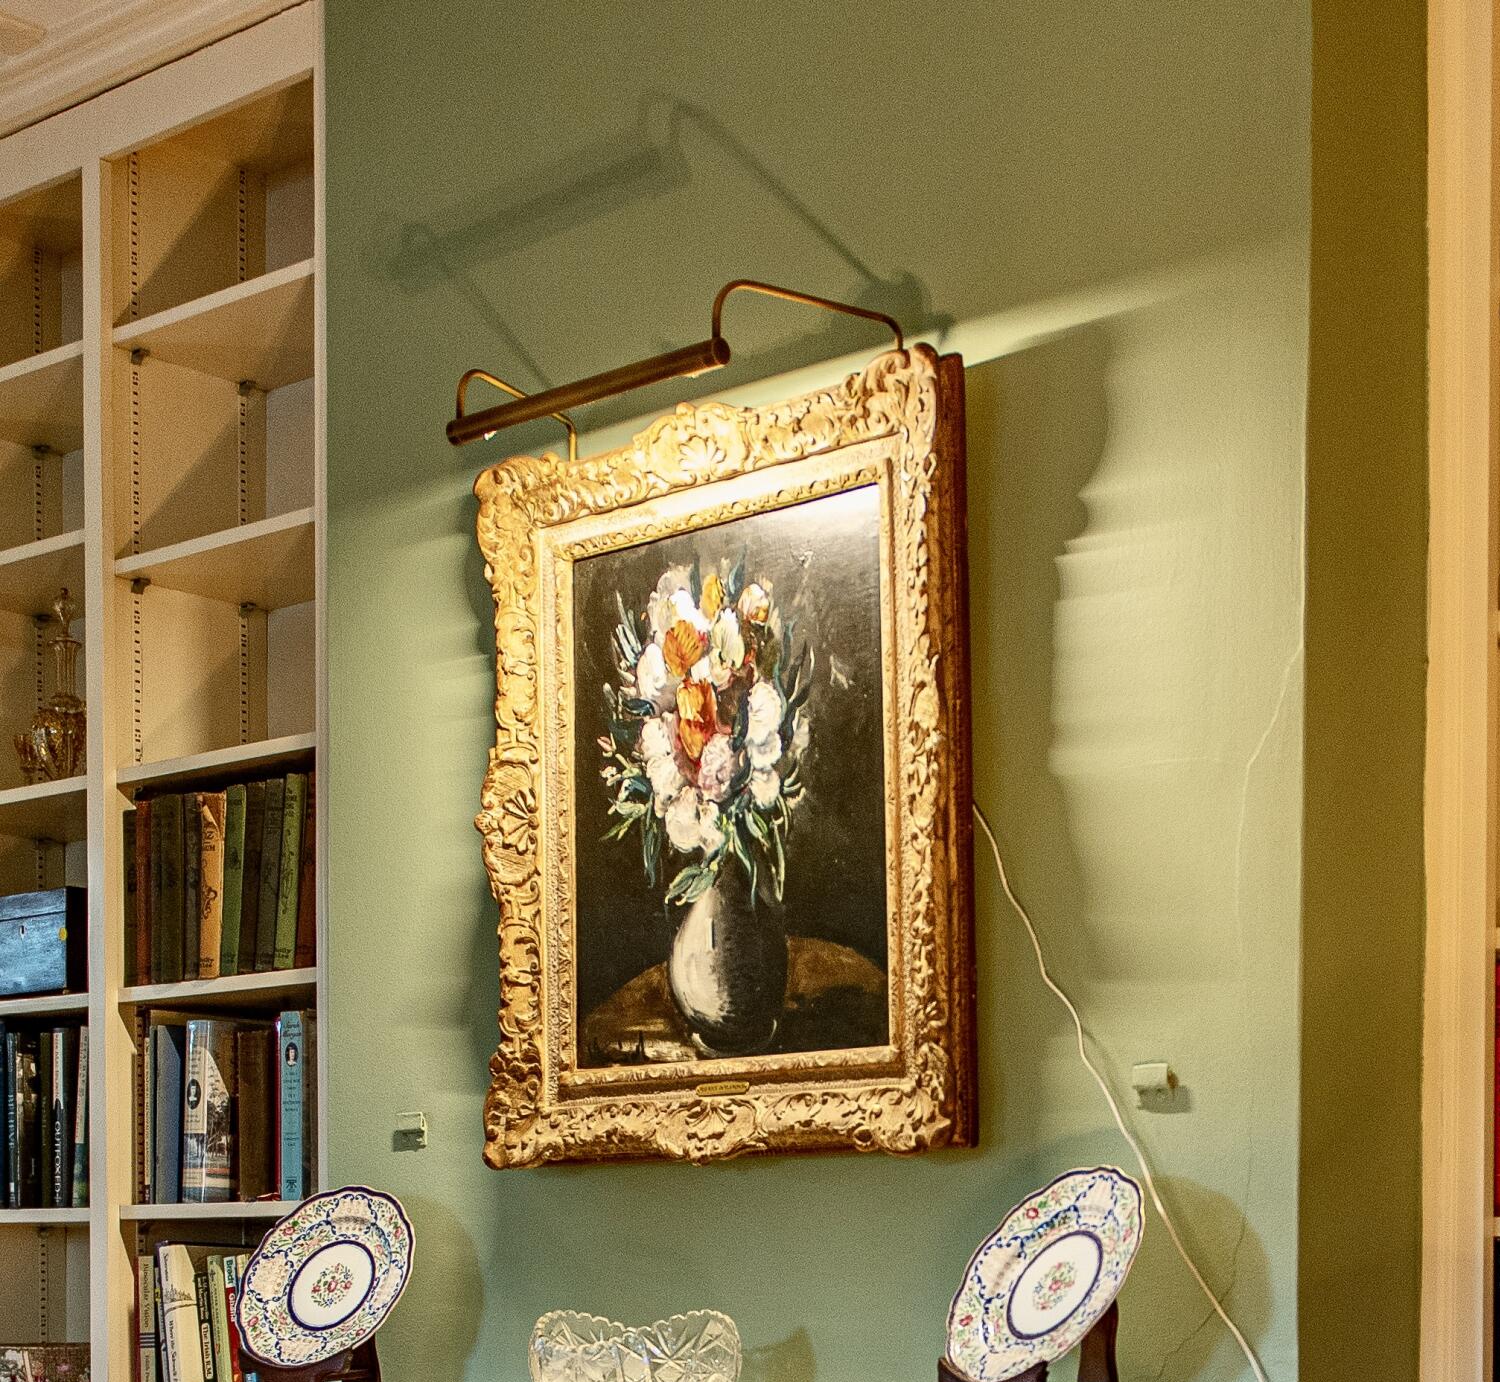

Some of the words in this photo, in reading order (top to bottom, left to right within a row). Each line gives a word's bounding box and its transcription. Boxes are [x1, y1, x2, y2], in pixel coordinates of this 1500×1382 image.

[53, 1121, 61, 1192] OUTFOXED
[162, 1253, 170, 1282] Silverstein
[225, 1259, 234, 1285] Bradt
[143, 1303, 151, 1328] Vision
[228, 1293, 237, 1323] Ghana
[203, 1341, 211, 1359] Irish
[170, 1351, 178, 1377] Sidewalk
